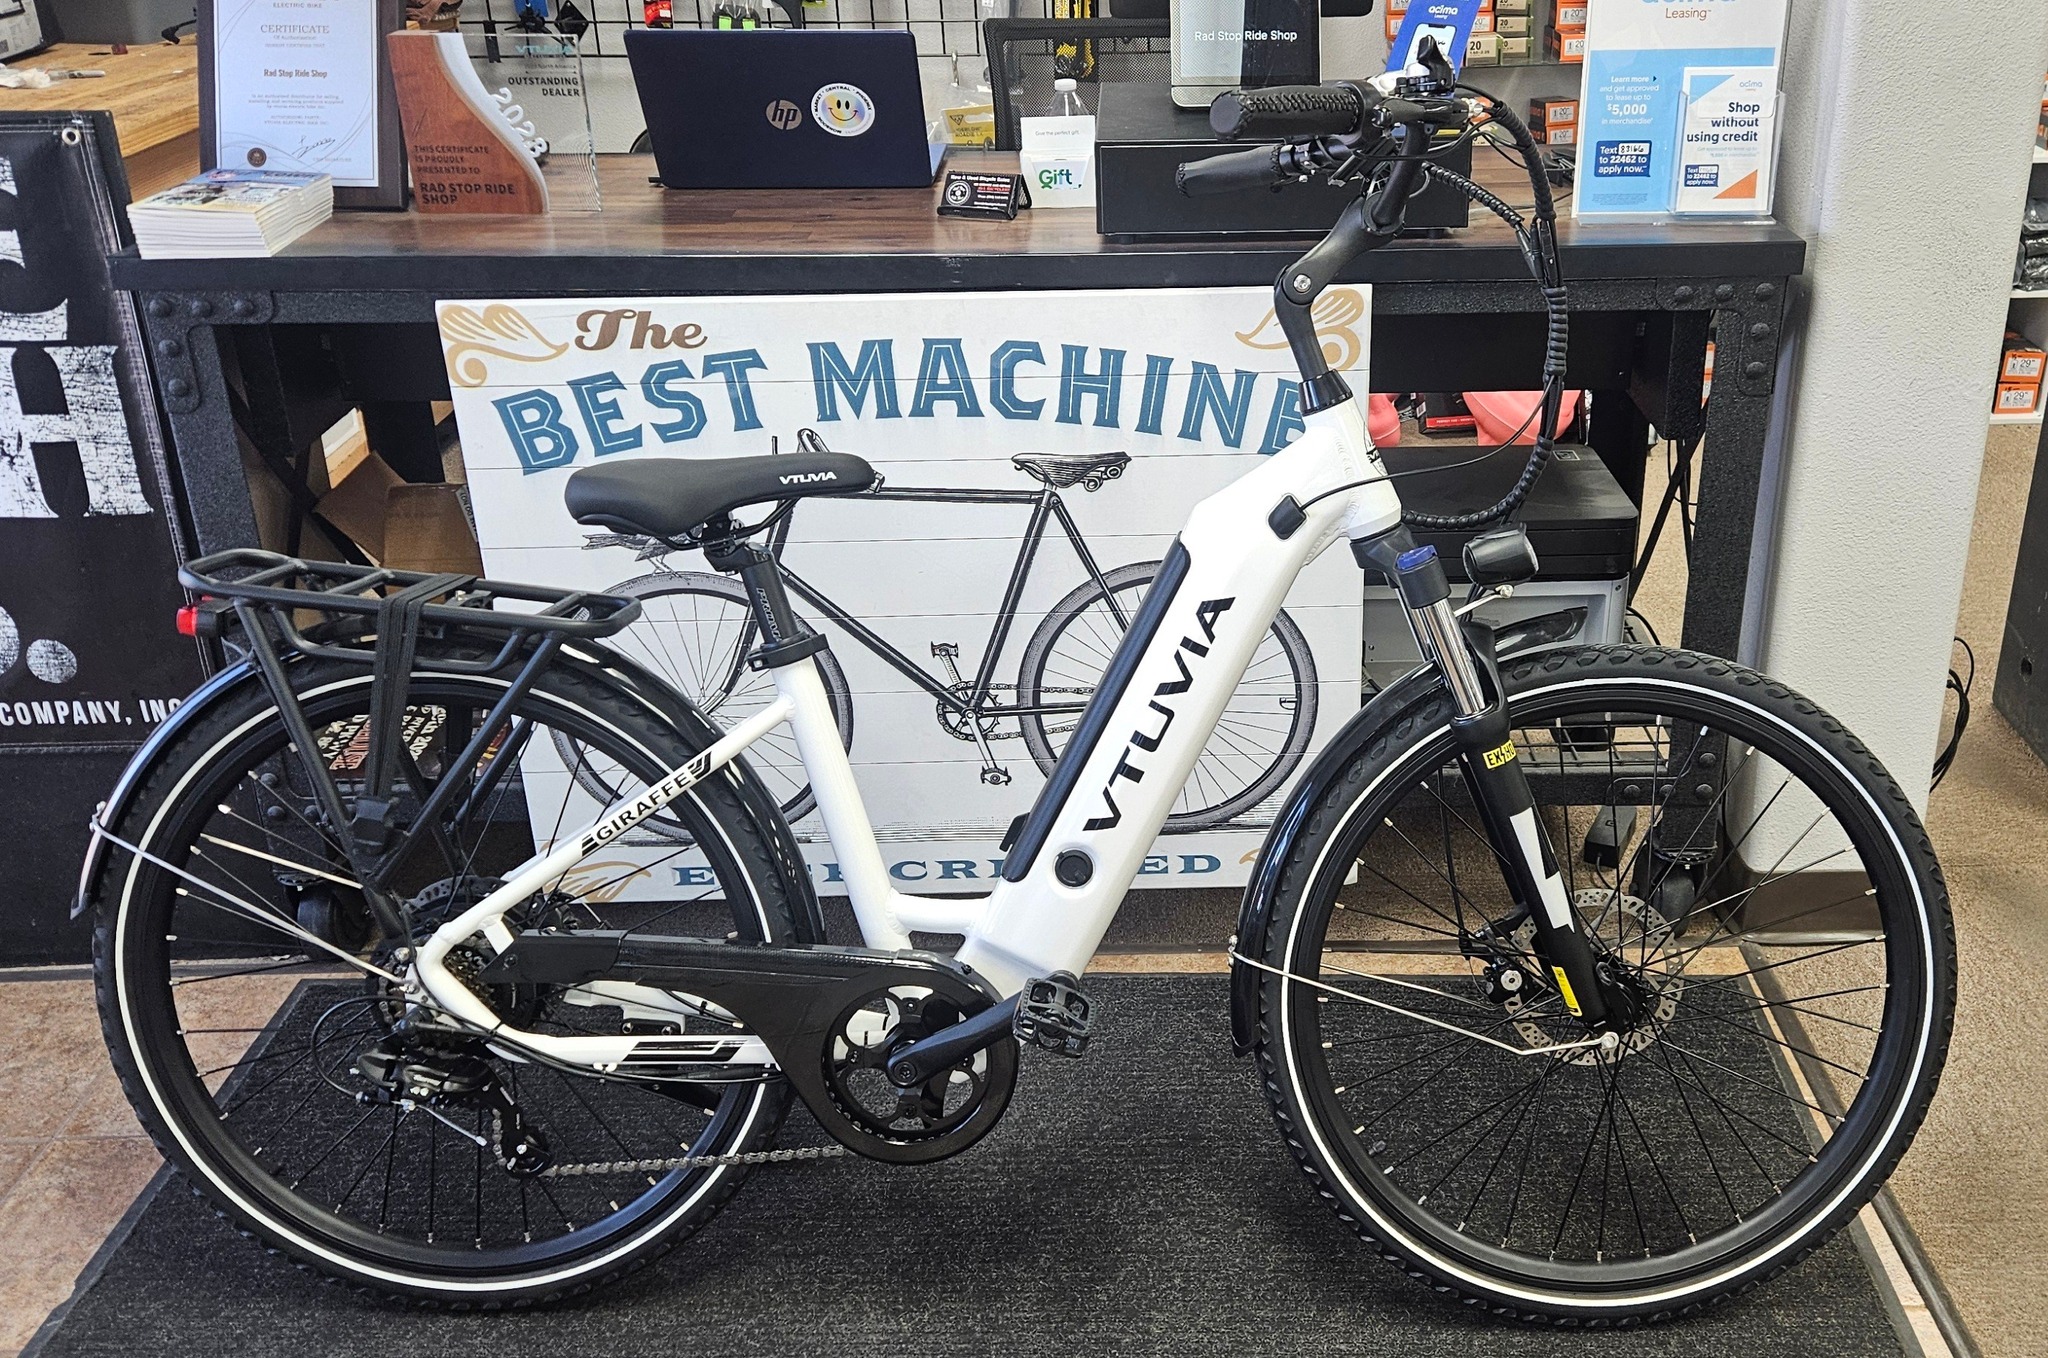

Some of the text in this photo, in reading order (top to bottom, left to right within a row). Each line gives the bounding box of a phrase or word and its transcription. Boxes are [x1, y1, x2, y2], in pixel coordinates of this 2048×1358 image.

[1428, 5, 1458, 15] acima
[260, 24, 330, 34] CERTIFICATE
[1194, 30, 1298, 42] Rad Stop Ride Shop
[1470, 40, 1482, 50] 20
[264, 69, 327, 78] Rad Stop Ride Shop
[508, 76, 578, 86] OUTSTANDING
[1740, 80, 1762, 88] acima
[542, 88, 580, 97] DEALER
[1626, 84, 1659, 93] approved
[1607, 104, 1647, 117] $5,000
[1728, 102, 1760, 115] Shop
[772, 100, 798, 130] hp
[1711, 116, 1759, 127] without
[1687, 131, 1758, 144] using credit
[414, 145, 489, 154] THIS CERTIFICATE
[1600, 146, 1617, 154] Text
[425, 156, 464, 164] PROUDLY
[1599, 156, 1608, 164] to
[418, 166, 466, 174] PRESENTED
[1598, 165, 1622, 174] apply
[1039, 169, 1072, 189] Gift
[420, 182, 516, 195] RAD STOP RIDE
[422, 194, 458, 205] SHOP
[574, 308, 709, 352] The
[491, 348, 768, 476] BEST
[779, 471, 837, 485] VTUVIA
[0, 700, 132, 726] COMPANY,
[1082, 596, 1236, 832] VTUVIA
[596, 772, 692, 842] GIRAFFE
